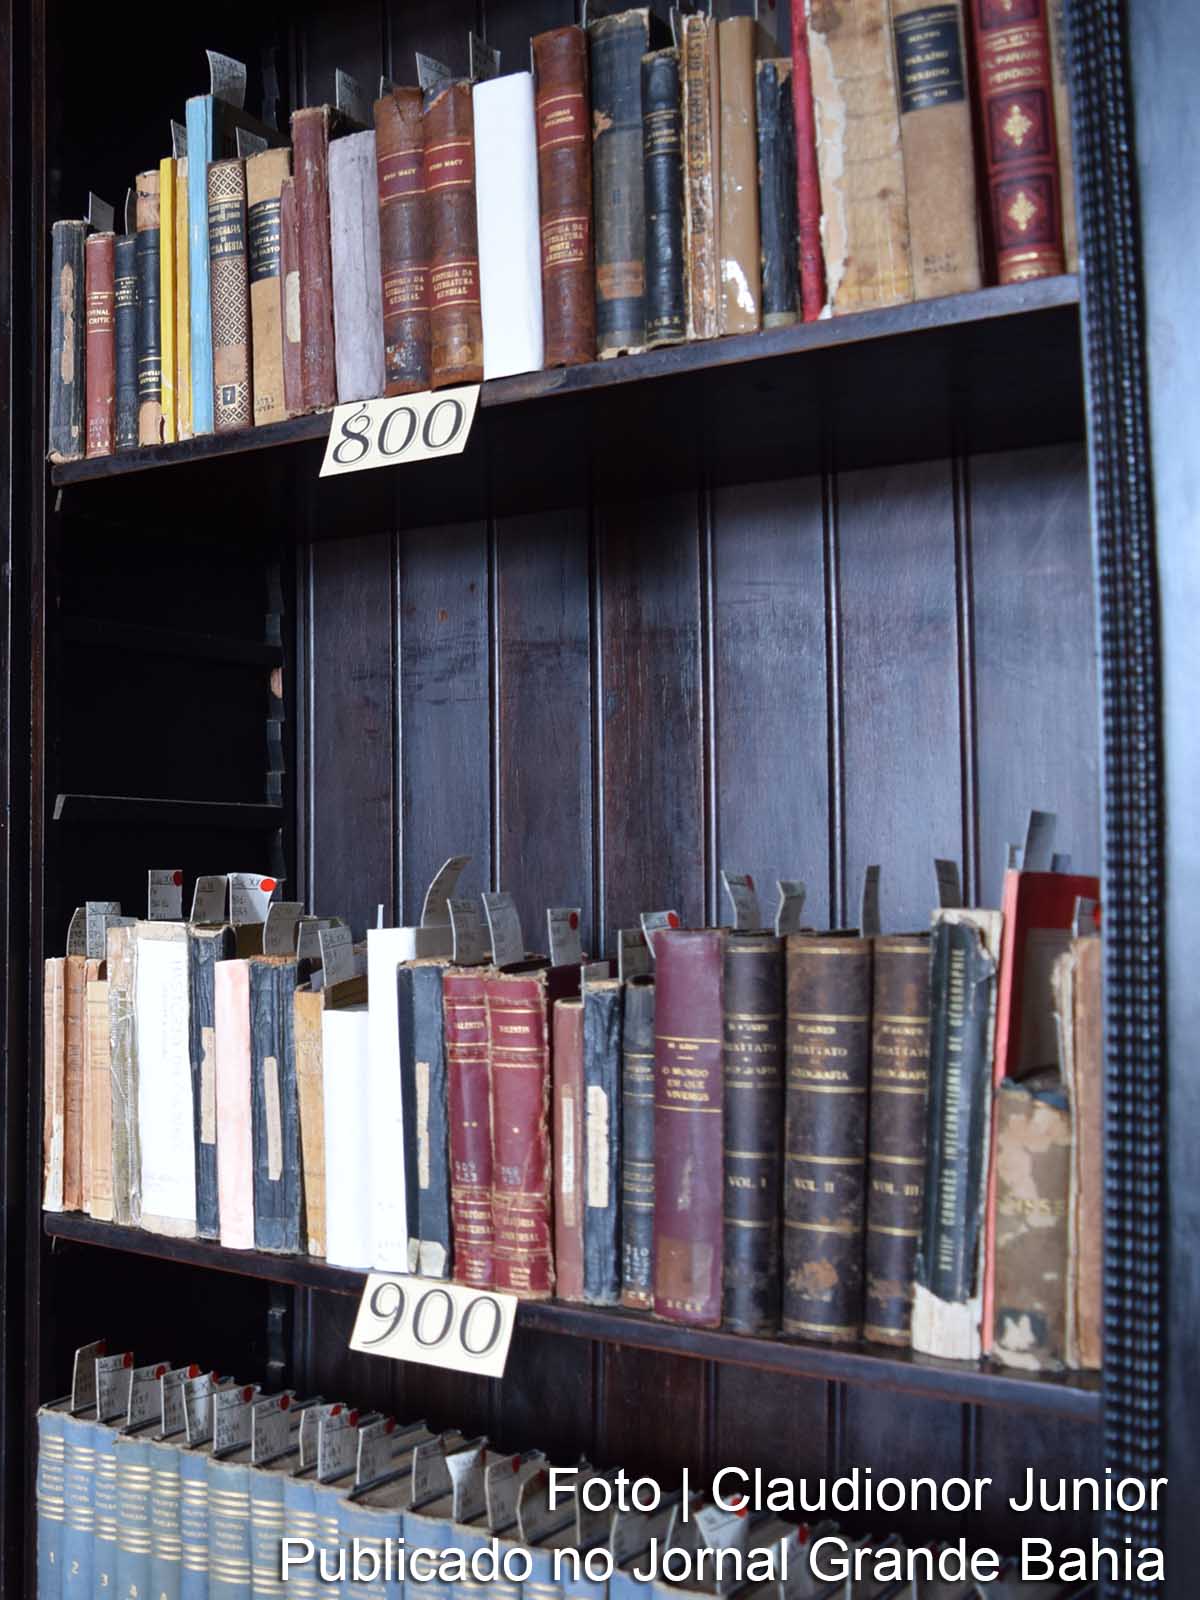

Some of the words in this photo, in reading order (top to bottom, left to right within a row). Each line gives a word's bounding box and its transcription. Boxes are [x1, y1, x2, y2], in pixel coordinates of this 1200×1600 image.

[331, 398, 465, 466] 800
[949, 948, 965, 1027] GÉOGRAPHIE
[949, 1036, 962, 1052] DE
[672, 1067, 710, 1079] MUNDO
[944, 1062, 962, 1161] INTERNATIONAL
[728, 1175, 756, 1189] VOL.
[793, 1177, 819, 1193] VOL.
[824, 1181, 835, 1194] II
[941, 1167, 957, 1226] CONGRÈS
[360, 1281, 503, 1357] 900
[49, 1551, 55, 1564] 1
[71, 1560, 80, 1575] 2
[101, 1573, 109, 1587] 3
